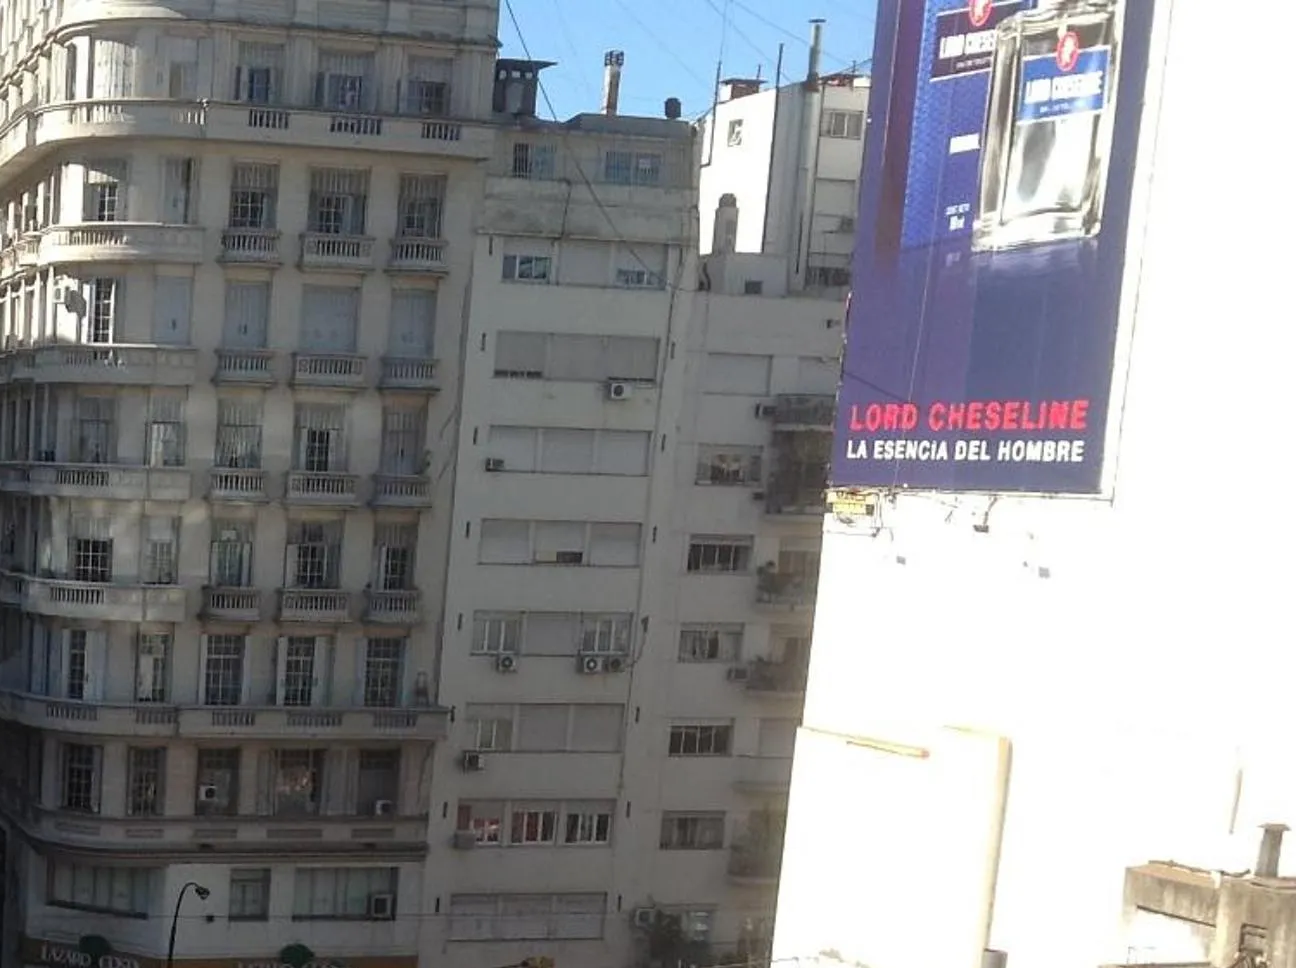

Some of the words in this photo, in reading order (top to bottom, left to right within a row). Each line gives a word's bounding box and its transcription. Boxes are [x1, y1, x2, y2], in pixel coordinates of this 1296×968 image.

[849, 403, 918, 431] LORD
[928, 399, 1090, 431] CHESELINE
[847, 440, 867, 460] LA
[954, 440, 990, 461] DEL
[998, 440, 1085, 462] HOMBRE
